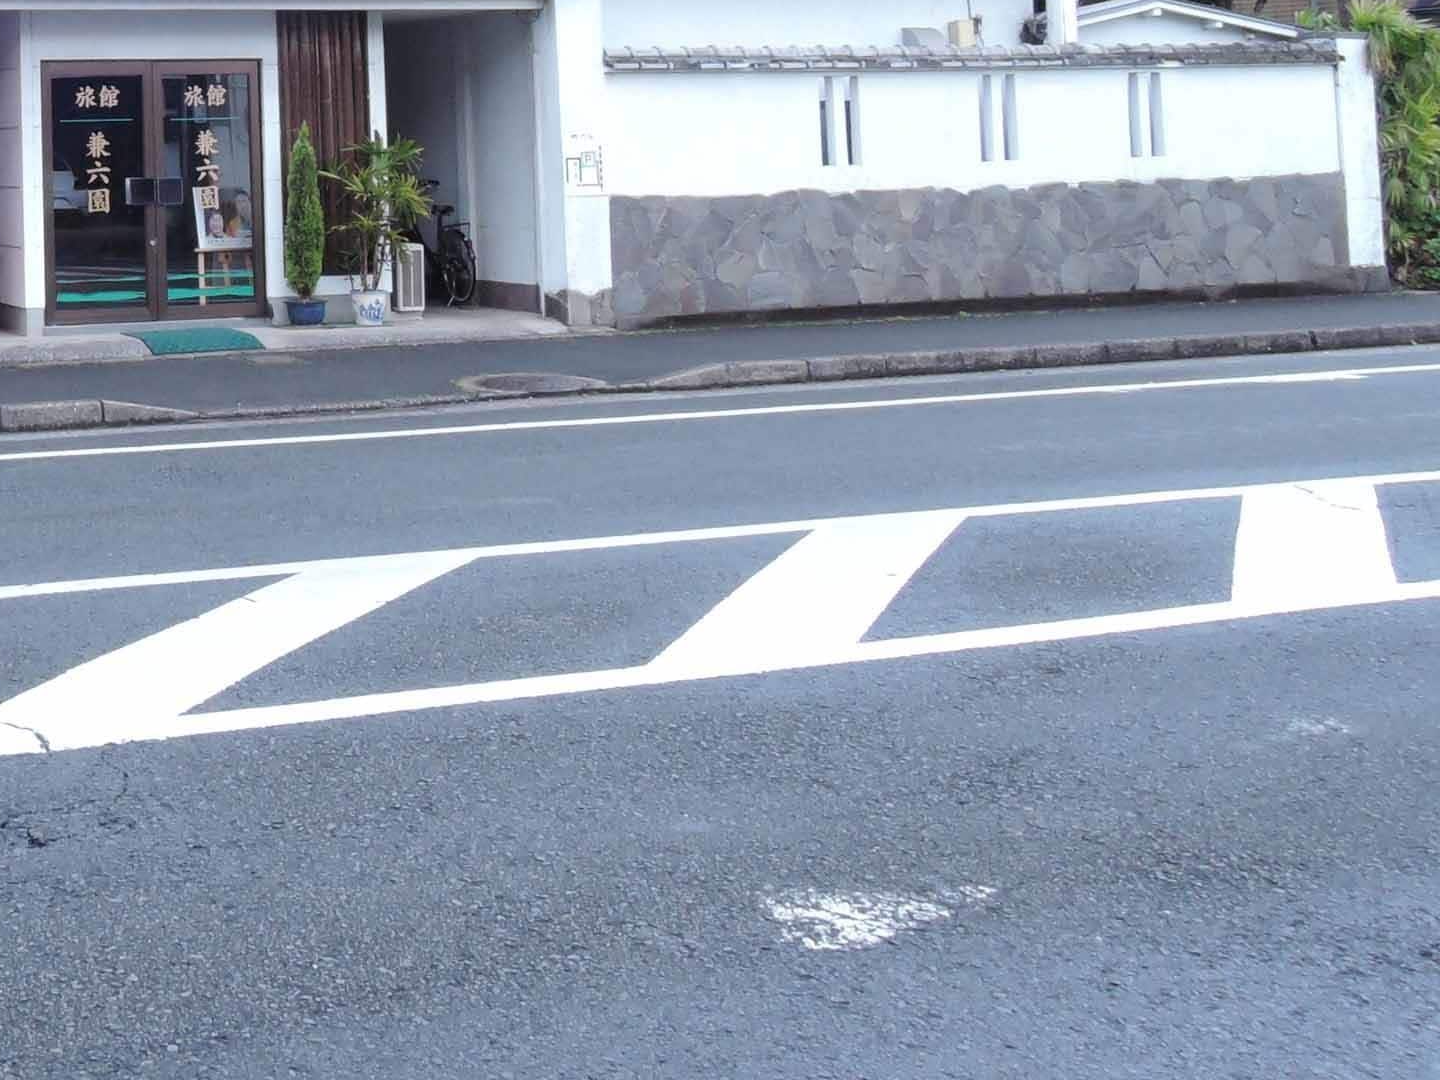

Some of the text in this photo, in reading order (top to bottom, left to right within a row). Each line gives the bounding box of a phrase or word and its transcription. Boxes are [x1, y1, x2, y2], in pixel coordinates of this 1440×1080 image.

[75, 85, 121, 108] 旅館
[183, 84, 227, 107] 旅館
[86, 131, 111, 214] 兼六園
[194, 130, 220, 211] 兼六園
